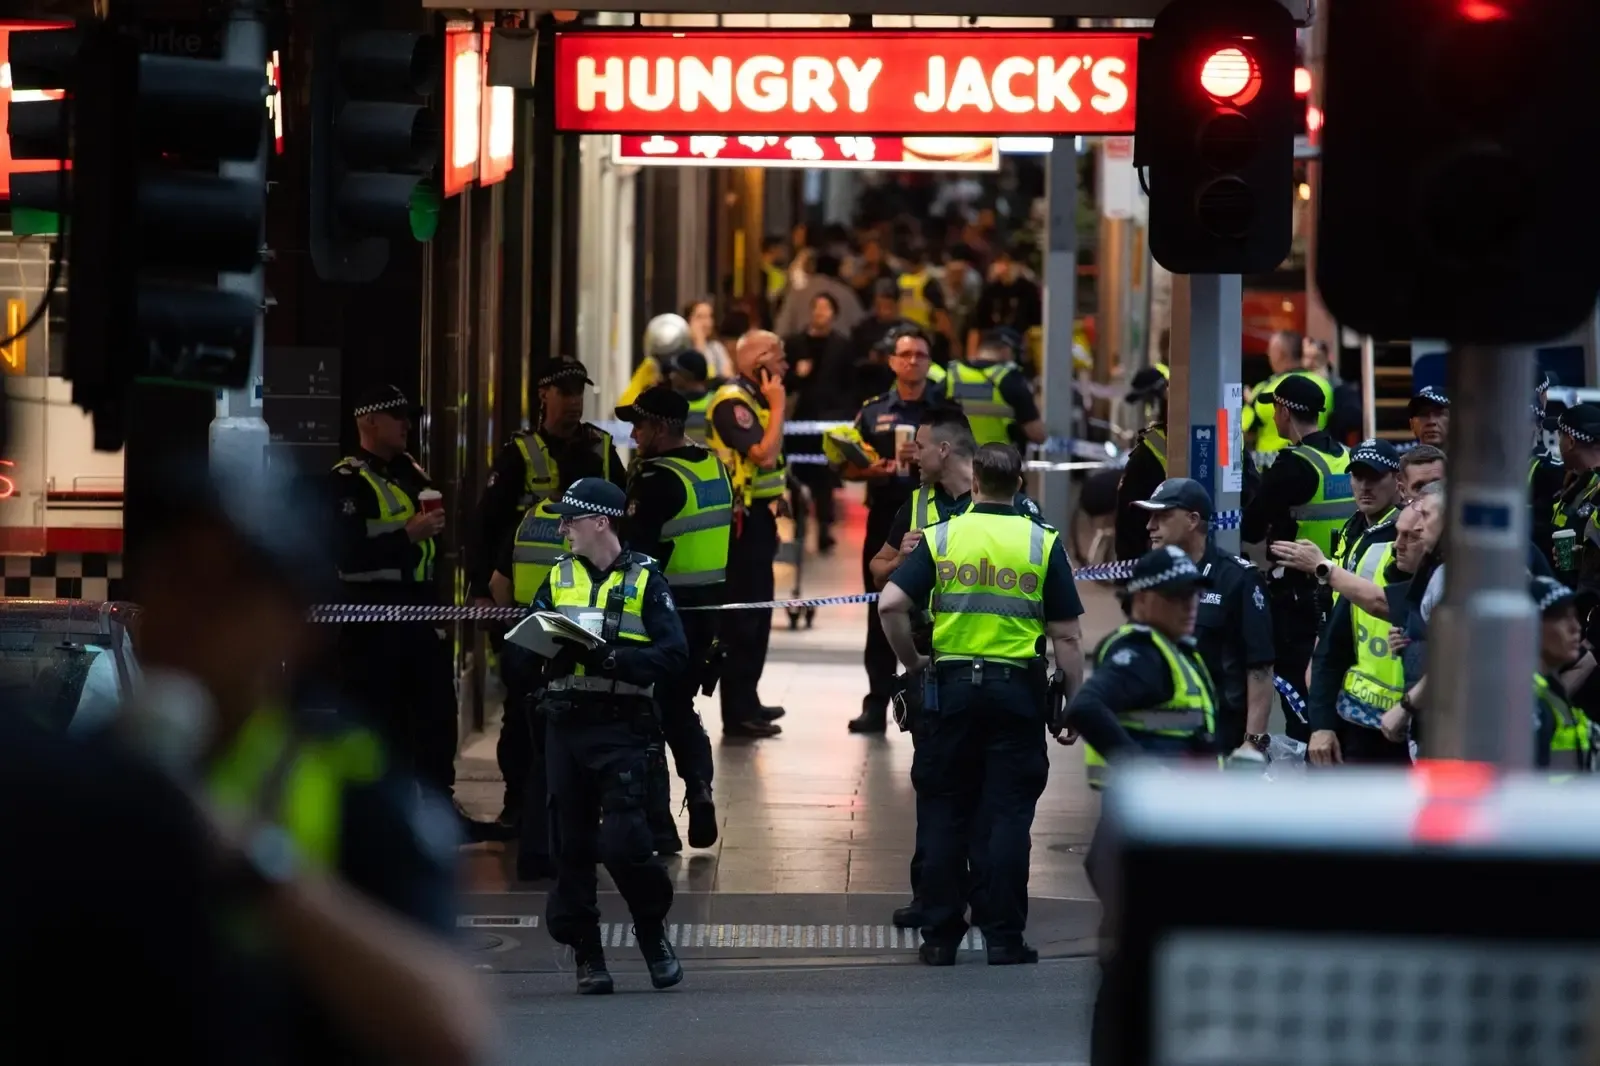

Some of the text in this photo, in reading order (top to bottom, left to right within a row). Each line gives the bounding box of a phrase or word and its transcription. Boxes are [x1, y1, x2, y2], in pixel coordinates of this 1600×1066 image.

[577, 55, 1129, 114] HUNGRY JACK'S
[936, 557, 1038, 594] Police
